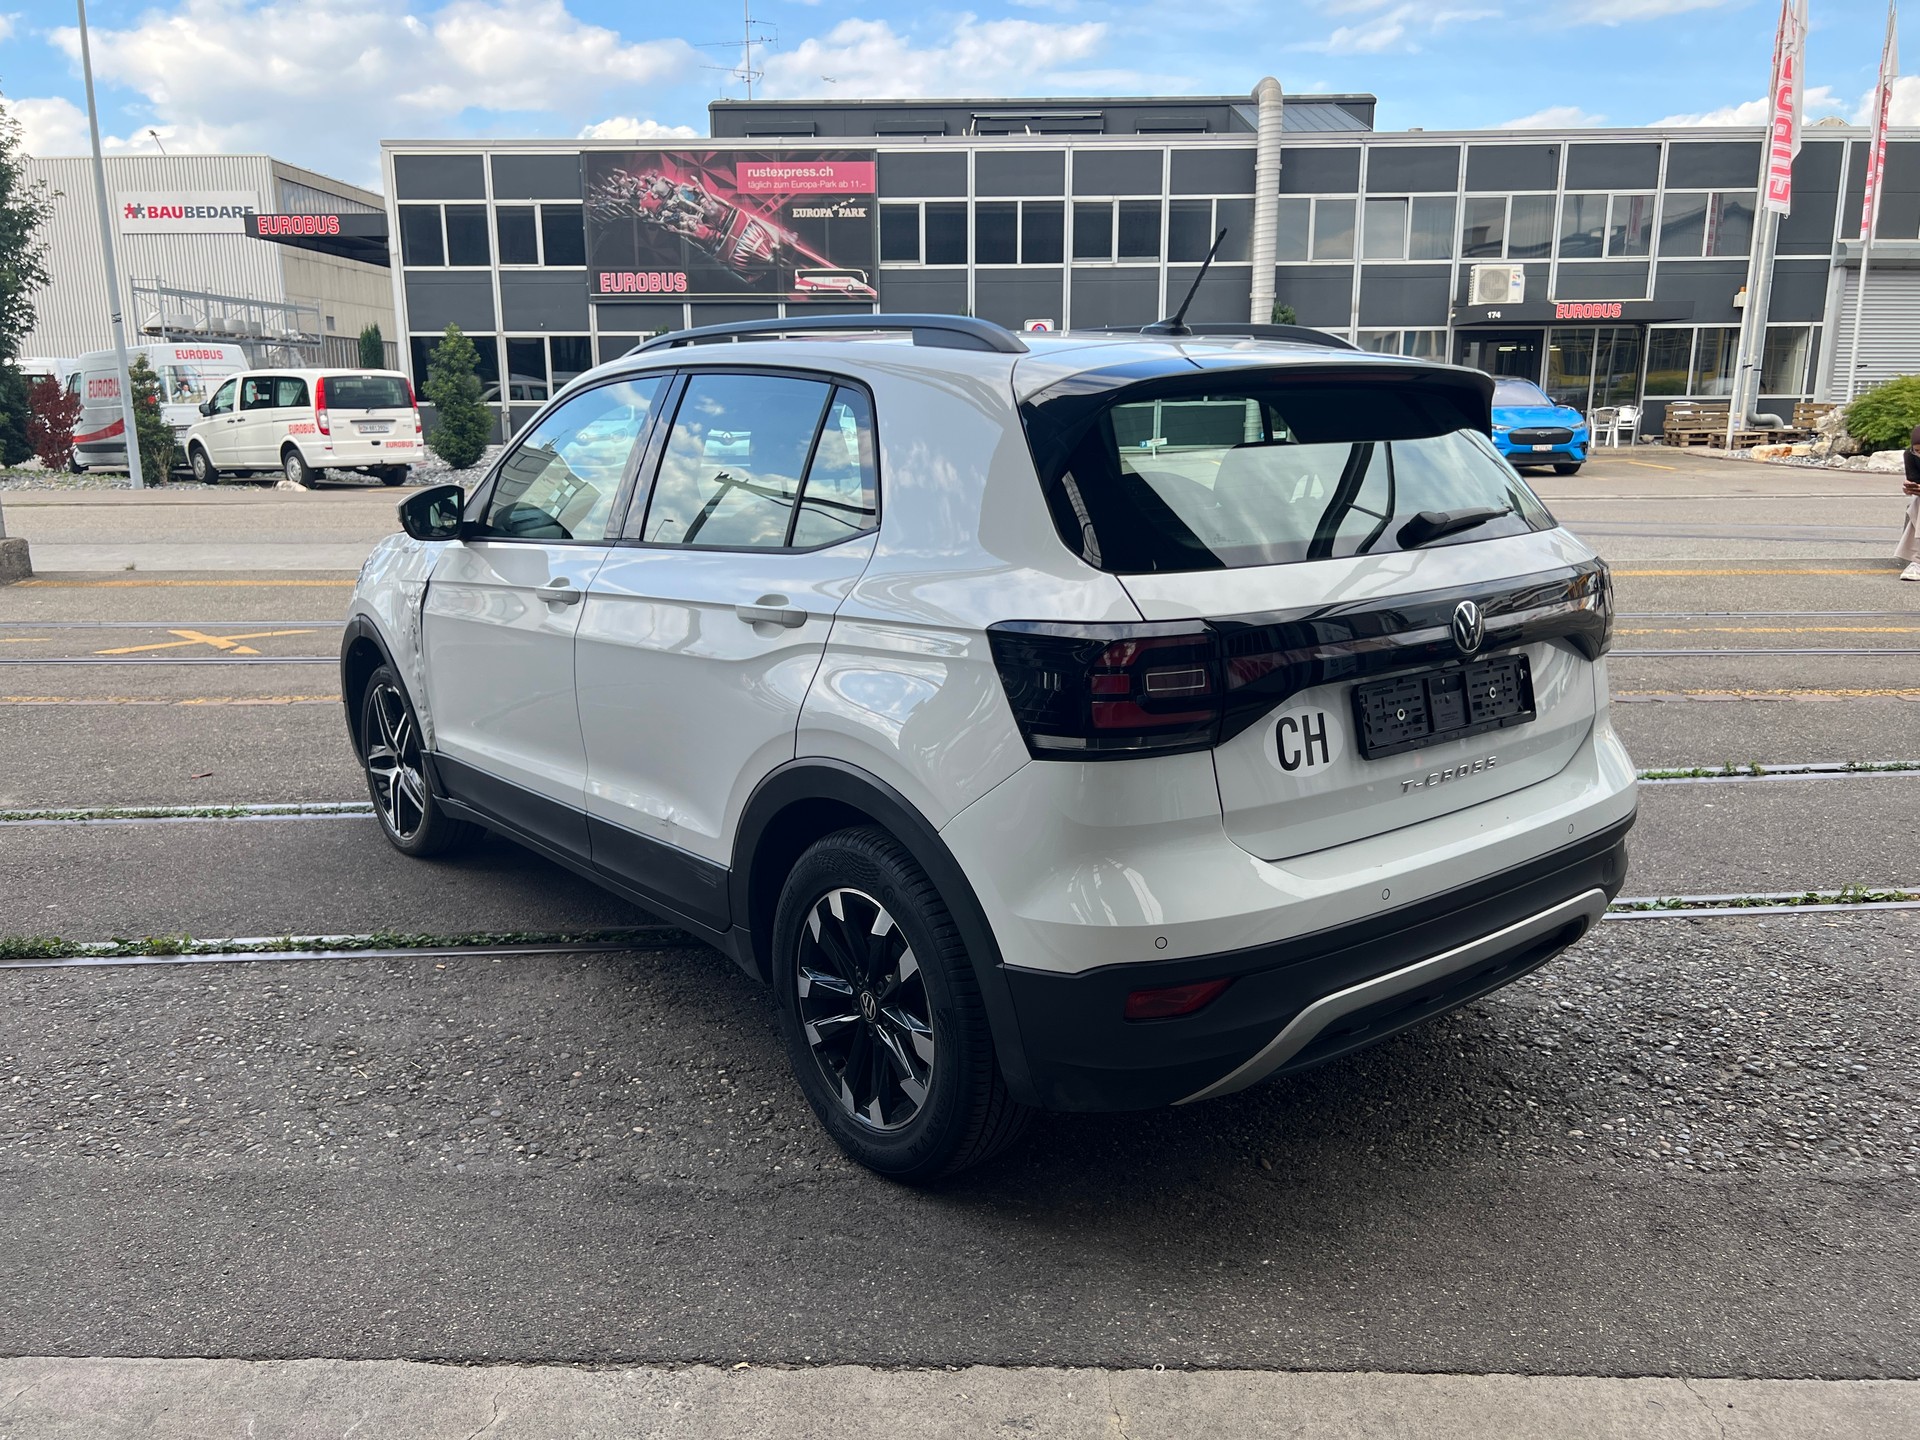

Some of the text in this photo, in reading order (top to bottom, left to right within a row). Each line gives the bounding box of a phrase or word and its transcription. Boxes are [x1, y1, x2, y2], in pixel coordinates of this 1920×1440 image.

[747, 166, 834, 179] rustexpress.ch
[747, 180, 772, 190] täglich
[790, 180, 837, 189] Europa-Park
[838, 180, 848, 188] ab
[792, 208, 866, 218] EUROPA PARK
[257, 215, 340, 235] EUROBUS
[599, 272, 687, 292] EUROBUS
[1487, 311, 1502, 319] 174
[1555, 303, 1622, 319] EUROBUS
[175, 349, 224, 360] EUROBUS
[88, 376, 121, 399] EUROBU
[288, 423, 316, 435] EUROBUS
[1275, 712, 1330, 772] CH
[1402, 755, 1497, 793] T-CROSS
